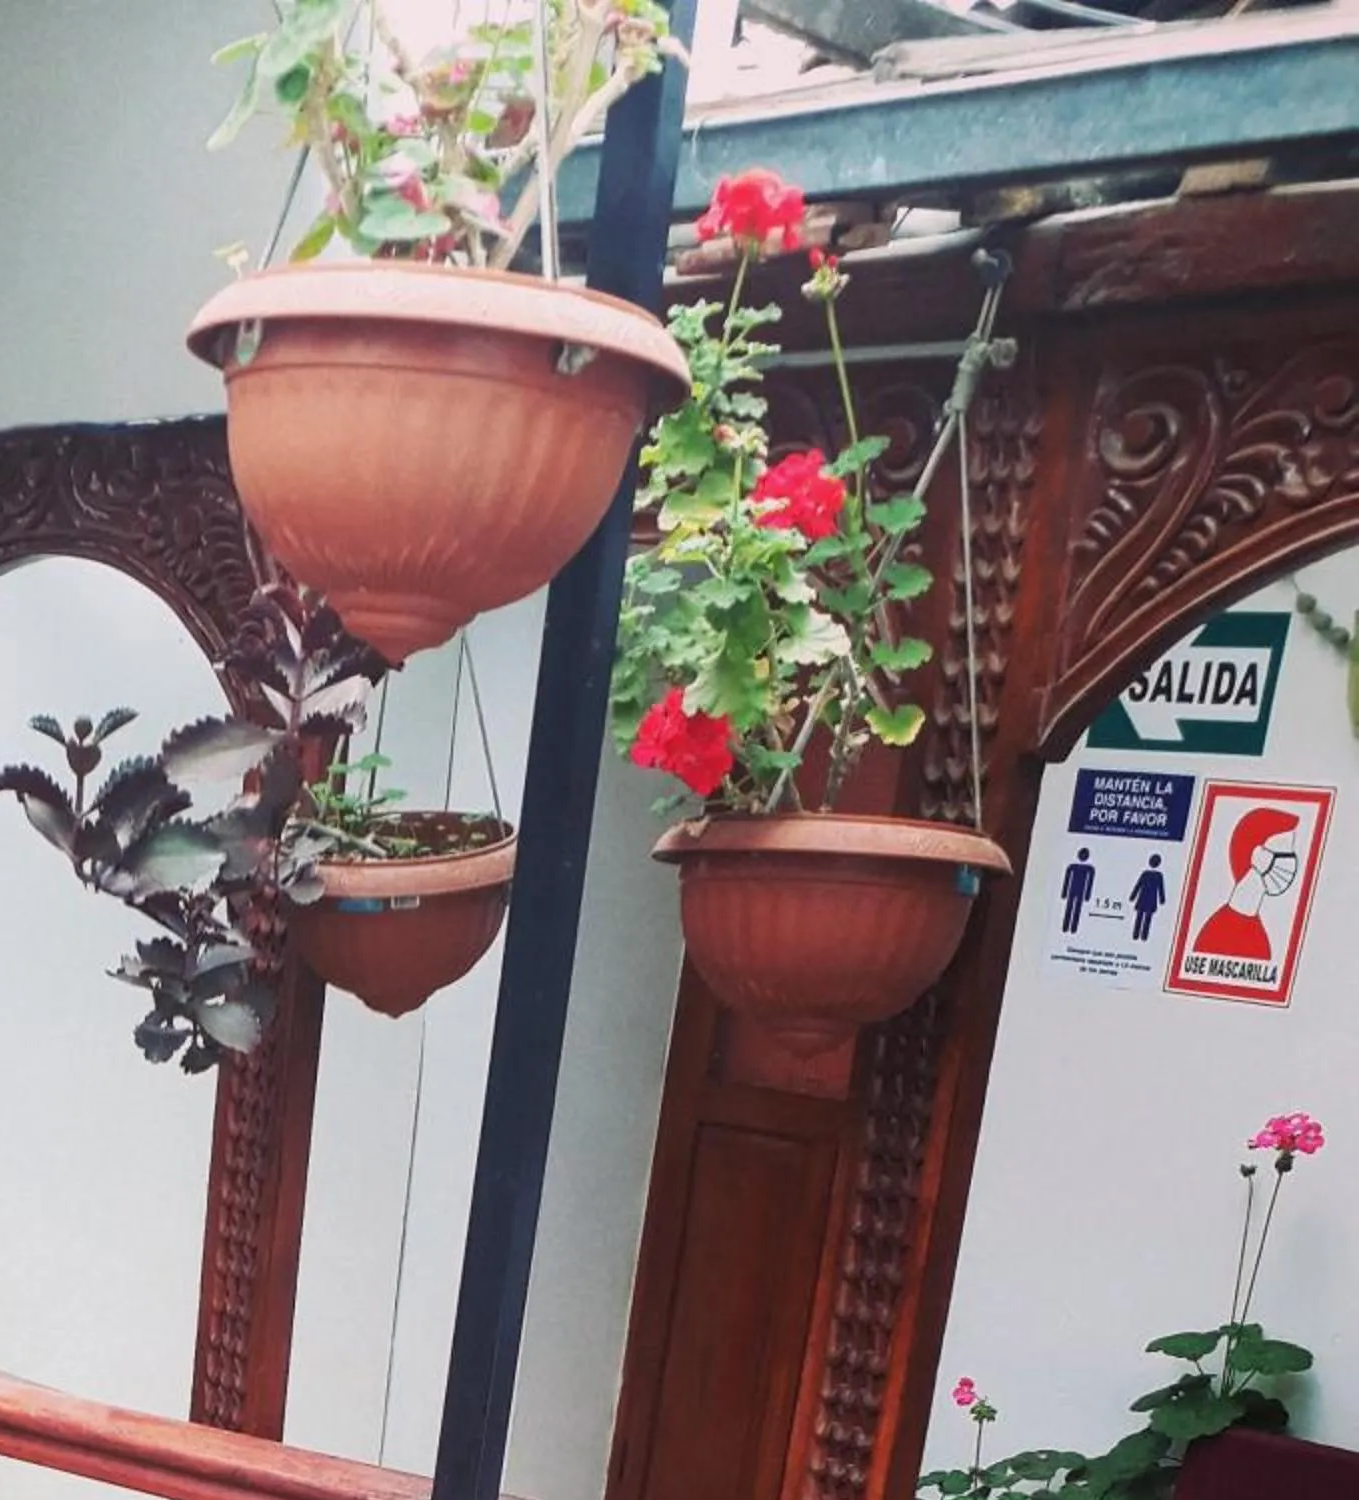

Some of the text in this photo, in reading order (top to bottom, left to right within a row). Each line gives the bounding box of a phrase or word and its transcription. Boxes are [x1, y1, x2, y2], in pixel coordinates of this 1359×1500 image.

[1093, 776, 1174, 795] MANTÉN LA
[1089, 808, 1168, 828] POR FAVOR
[1112, 902, 1122, 910] m
[1184, 955, 1278, 984] USE MASCARILLA
